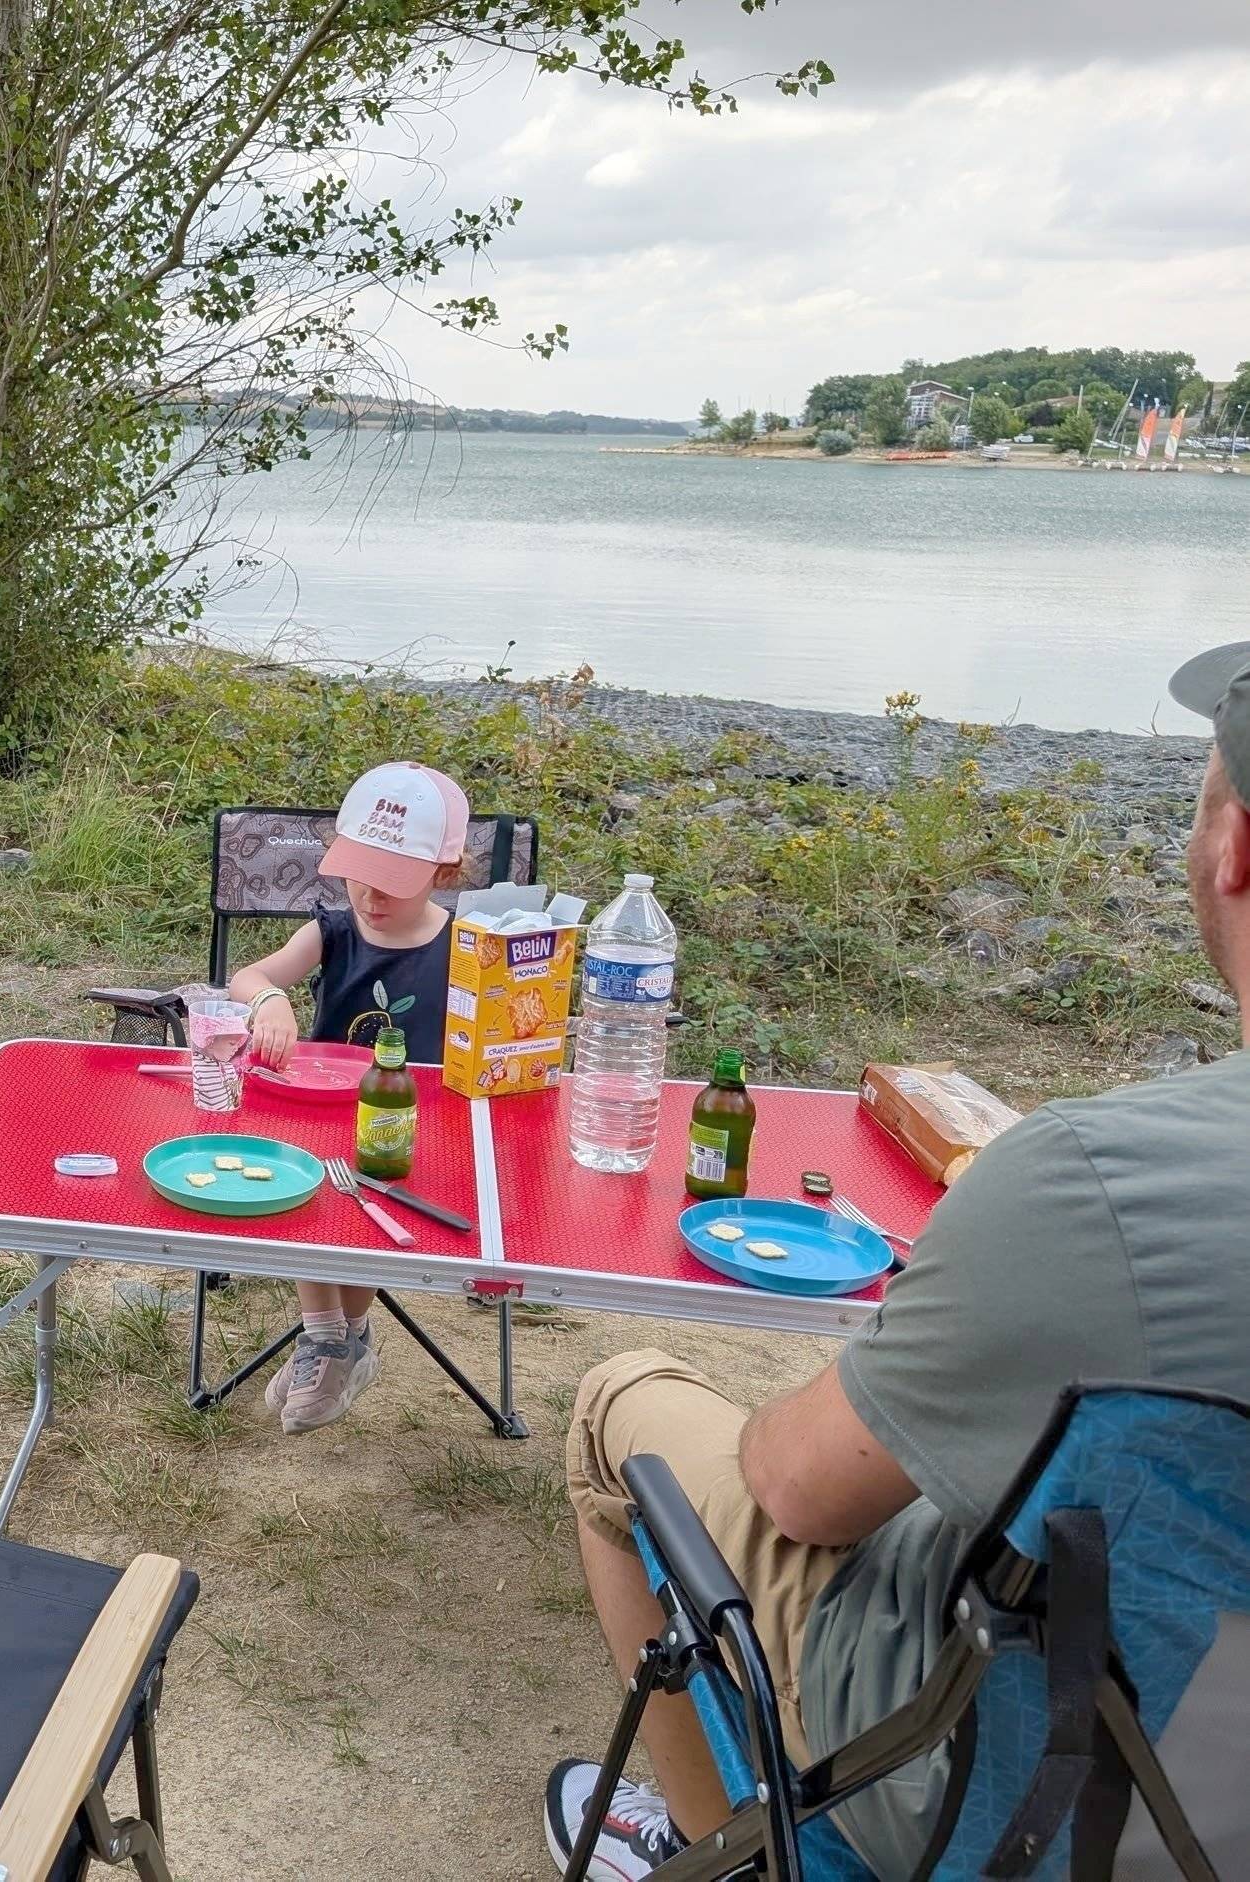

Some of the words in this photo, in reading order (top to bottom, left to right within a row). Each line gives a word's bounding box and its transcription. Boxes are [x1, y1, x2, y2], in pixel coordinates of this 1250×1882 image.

[375, 799, 407, 817] BIM
[367, 811, 405, 832] BAM
[358, 823, 405, 847] BOOM
[514, 965, 548, 978] MONACO
[488, 1046, 518, 1056] CRAQUEZ
